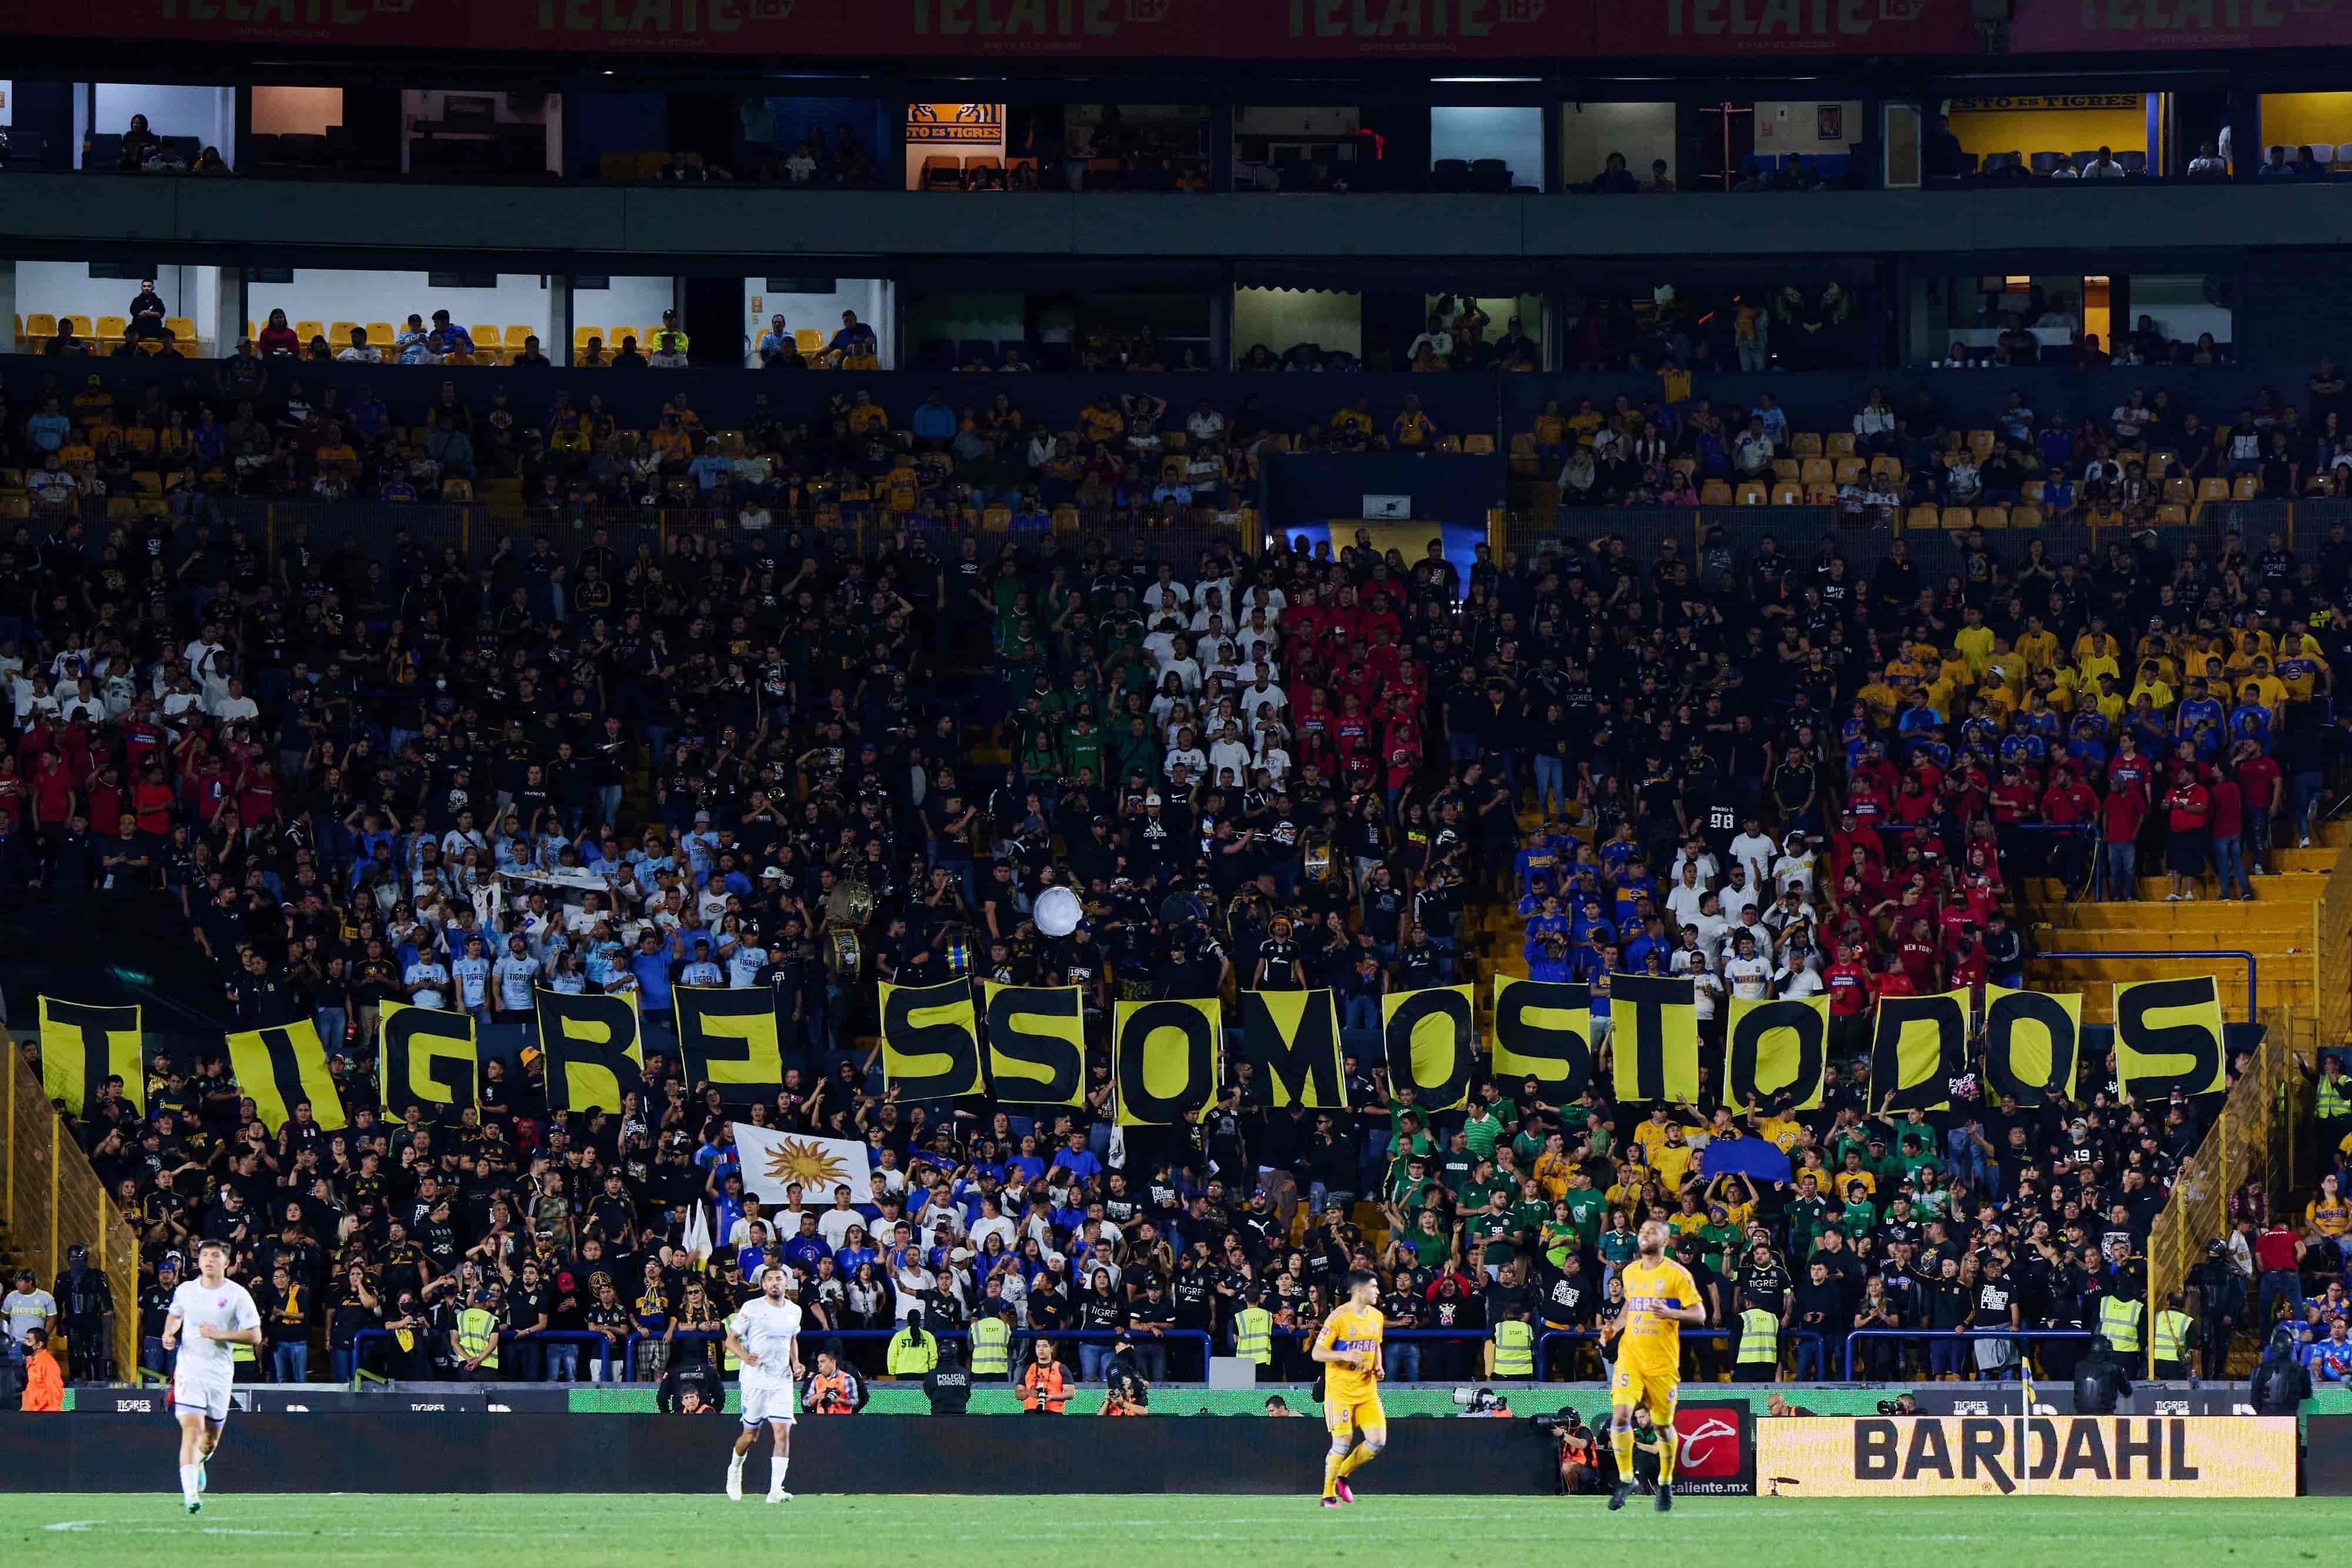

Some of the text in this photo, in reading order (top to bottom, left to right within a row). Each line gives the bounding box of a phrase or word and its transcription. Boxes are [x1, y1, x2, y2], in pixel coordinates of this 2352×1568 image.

[2043, 95, 2137, 107] TIGRES
[947, 128, 1000, 137] TIGRES
[1709, 813, 1734, 829] 98
[509, 972, 531, 981] TIGRES
[1070, 969, 1089, 977] 1998
[1949, 1073, 1976, 1088] KILLED
[2073, 1149, 2090, 1162] 19
[1749, 1279, 1779, 1288] TIGRES
[1621, 1373, 1629, 1388] 5
[116, 1400, 151, 1412] TIGRES
[1343, 1409, 1349, 1423] 9
[1853, 1417, 2199, 1494] BARDAHL
[1670, 1482, 1749, 1494] caliente.mx
